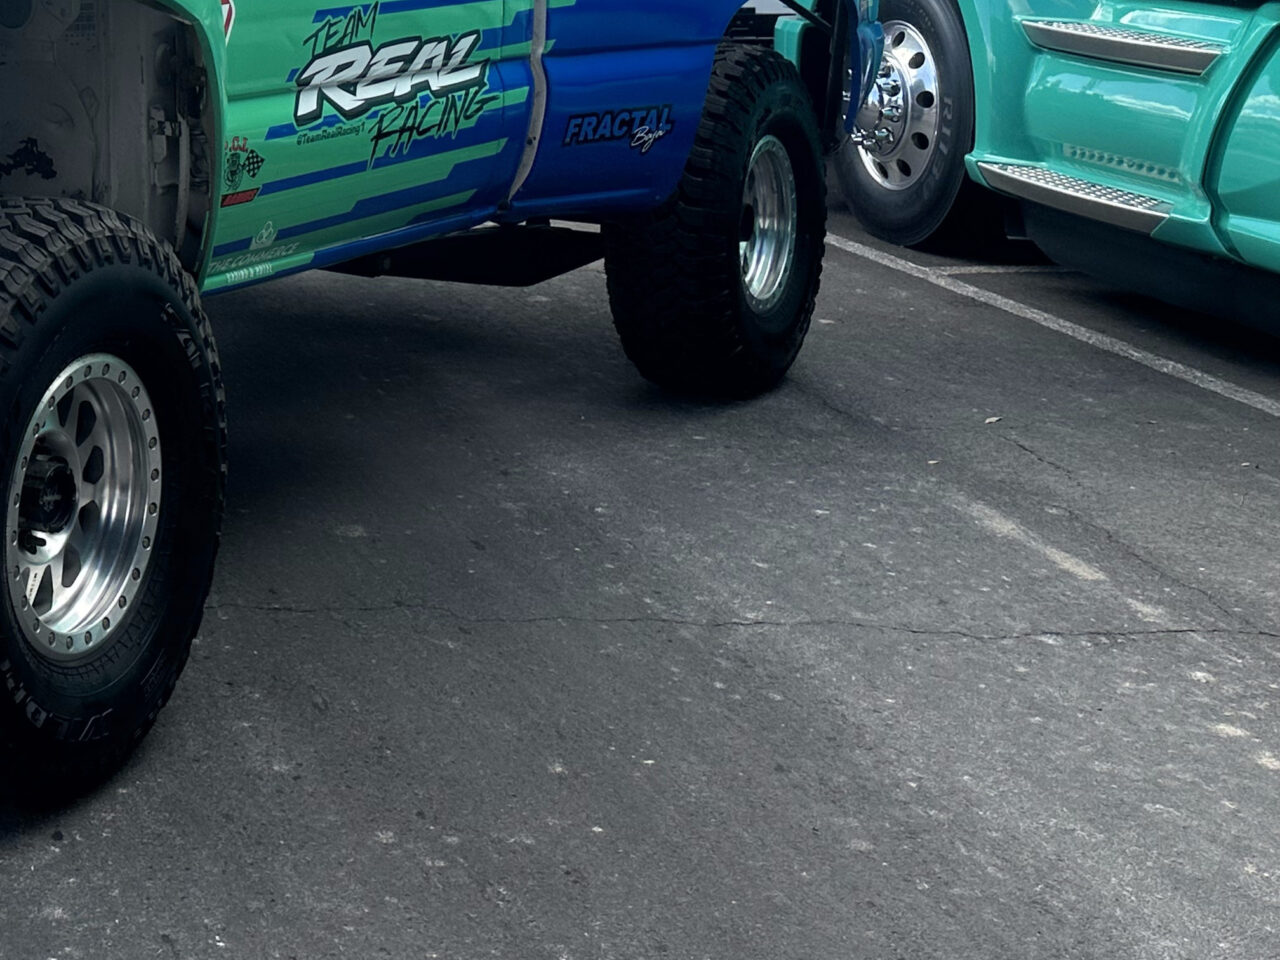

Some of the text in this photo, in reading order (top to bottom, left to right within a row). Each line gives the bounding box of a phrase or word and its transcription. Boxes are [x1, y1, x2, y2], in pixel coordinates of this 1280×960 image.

[303, 1, 379, 58] TEAM
[296, 30, 489, 125] REAL
[368, 88, 499, 169] RACING
[564, 108, 671, 144] FRACTAL
